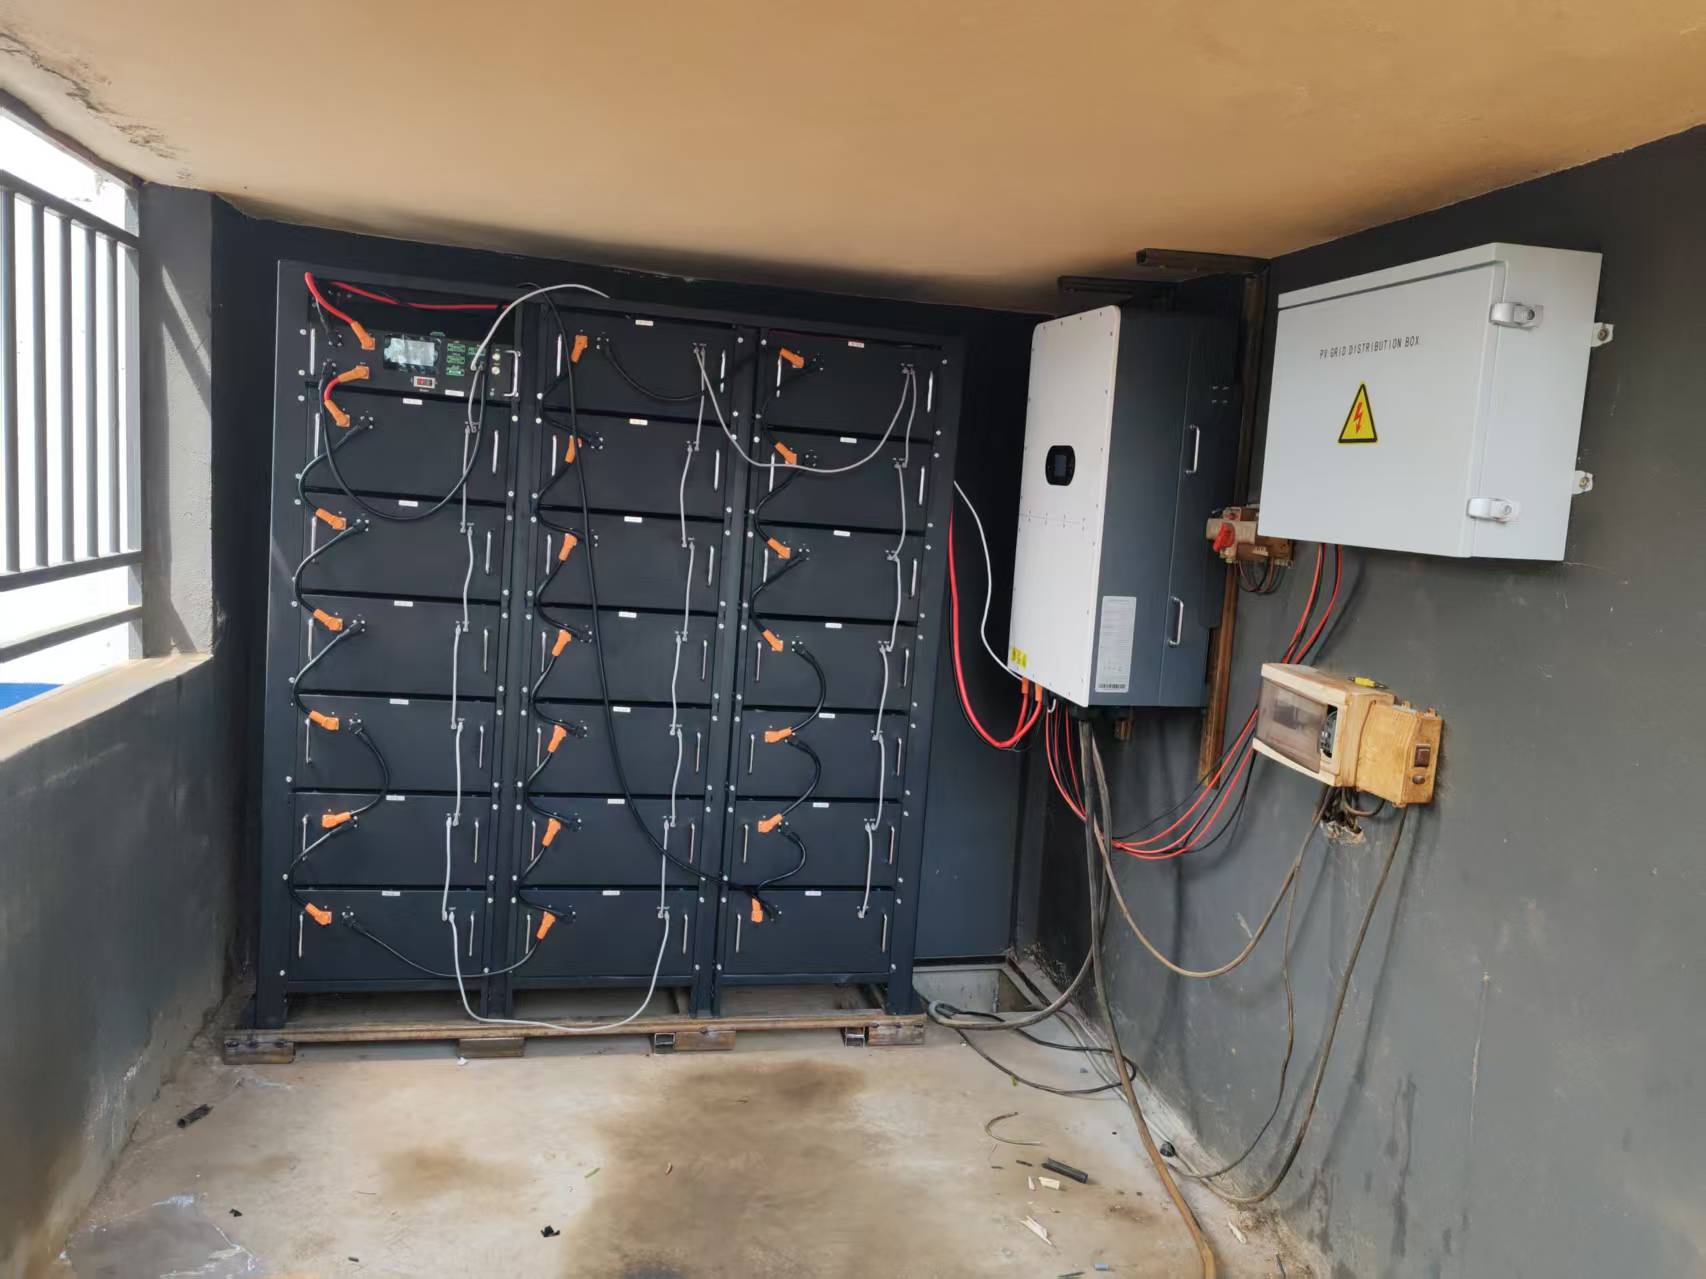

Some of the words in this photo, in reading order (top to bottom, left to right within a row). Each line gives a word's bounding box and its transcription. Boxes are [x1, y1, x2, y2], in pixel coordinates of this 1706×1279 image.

[1330, 346, 1346, 358] GRID
[1348, 337, 1402, 355] DISTRIBUTION
[1405, 335, 1420, 348] BOX
